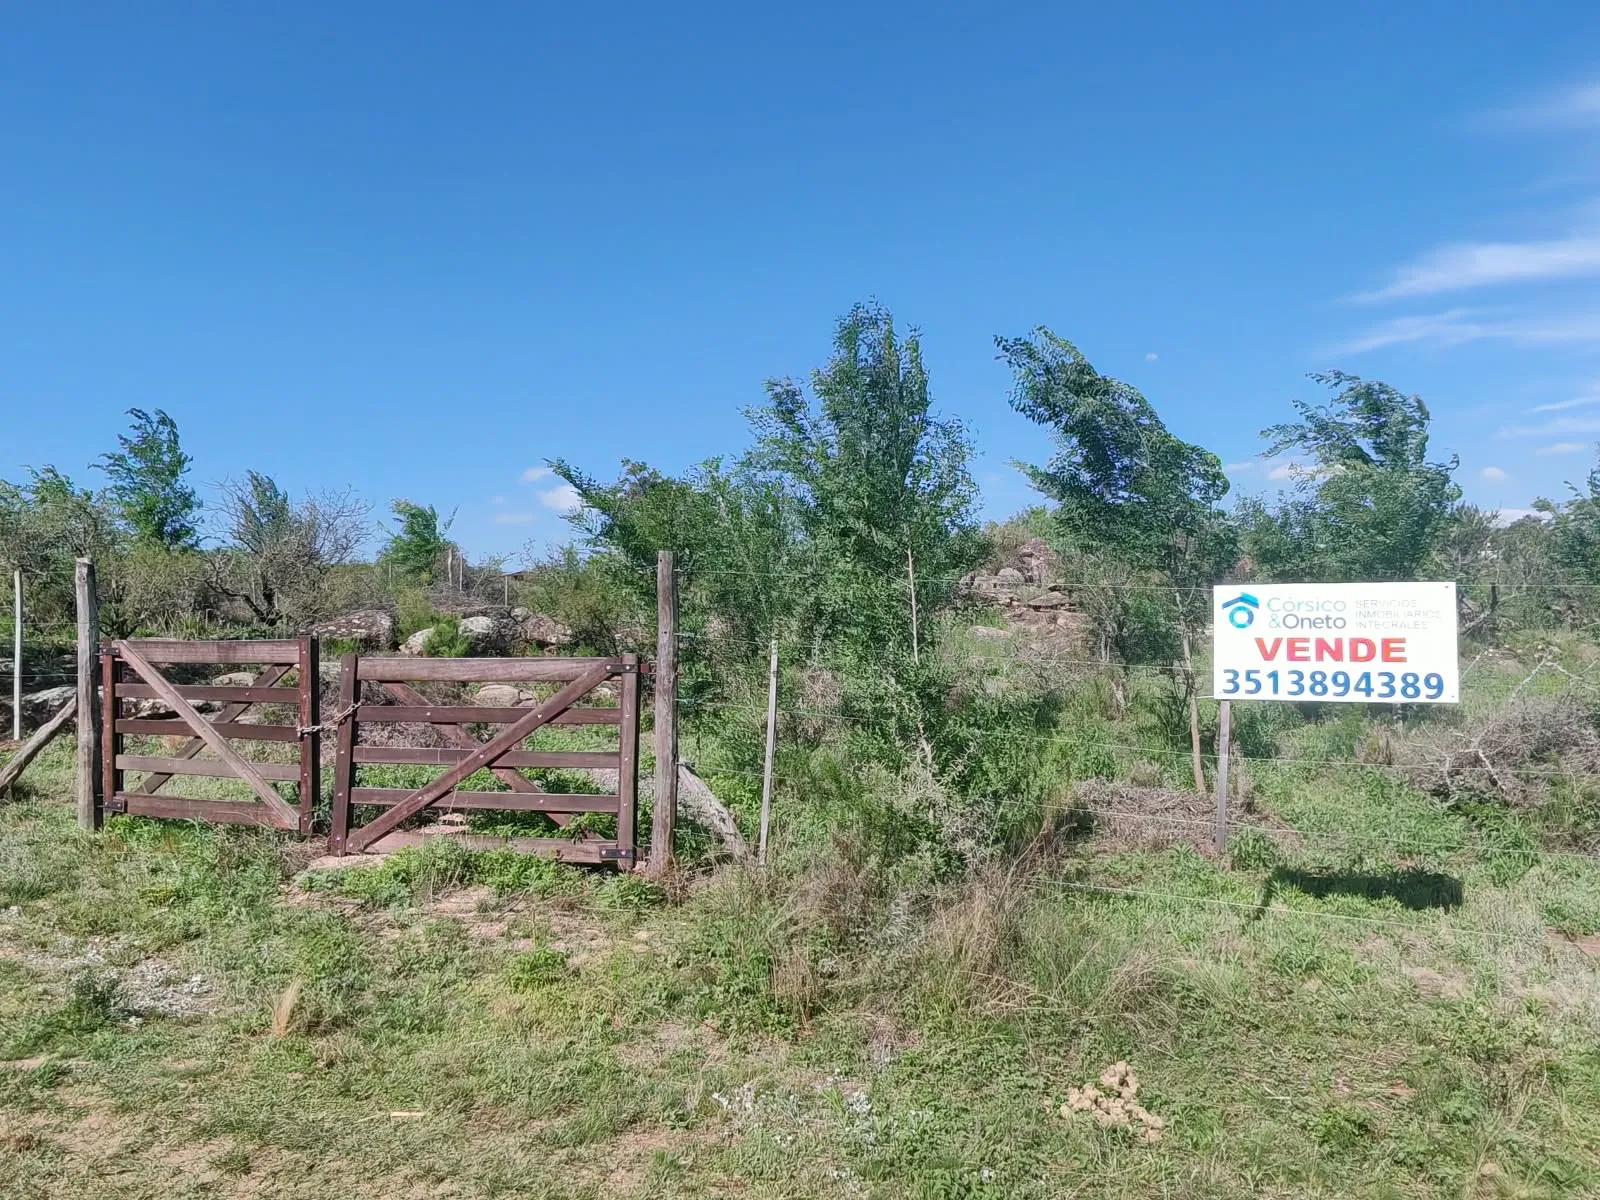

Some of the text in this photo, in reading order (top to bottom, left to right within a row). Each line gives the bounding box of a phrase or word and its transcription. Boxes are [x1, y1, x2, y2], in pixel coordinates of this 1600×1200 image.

[1267, 597, 1346, 613] Córsico
[1254, 637, 1407, 662] VENDE
[1222, 669, 1444, 699] 3513894389
